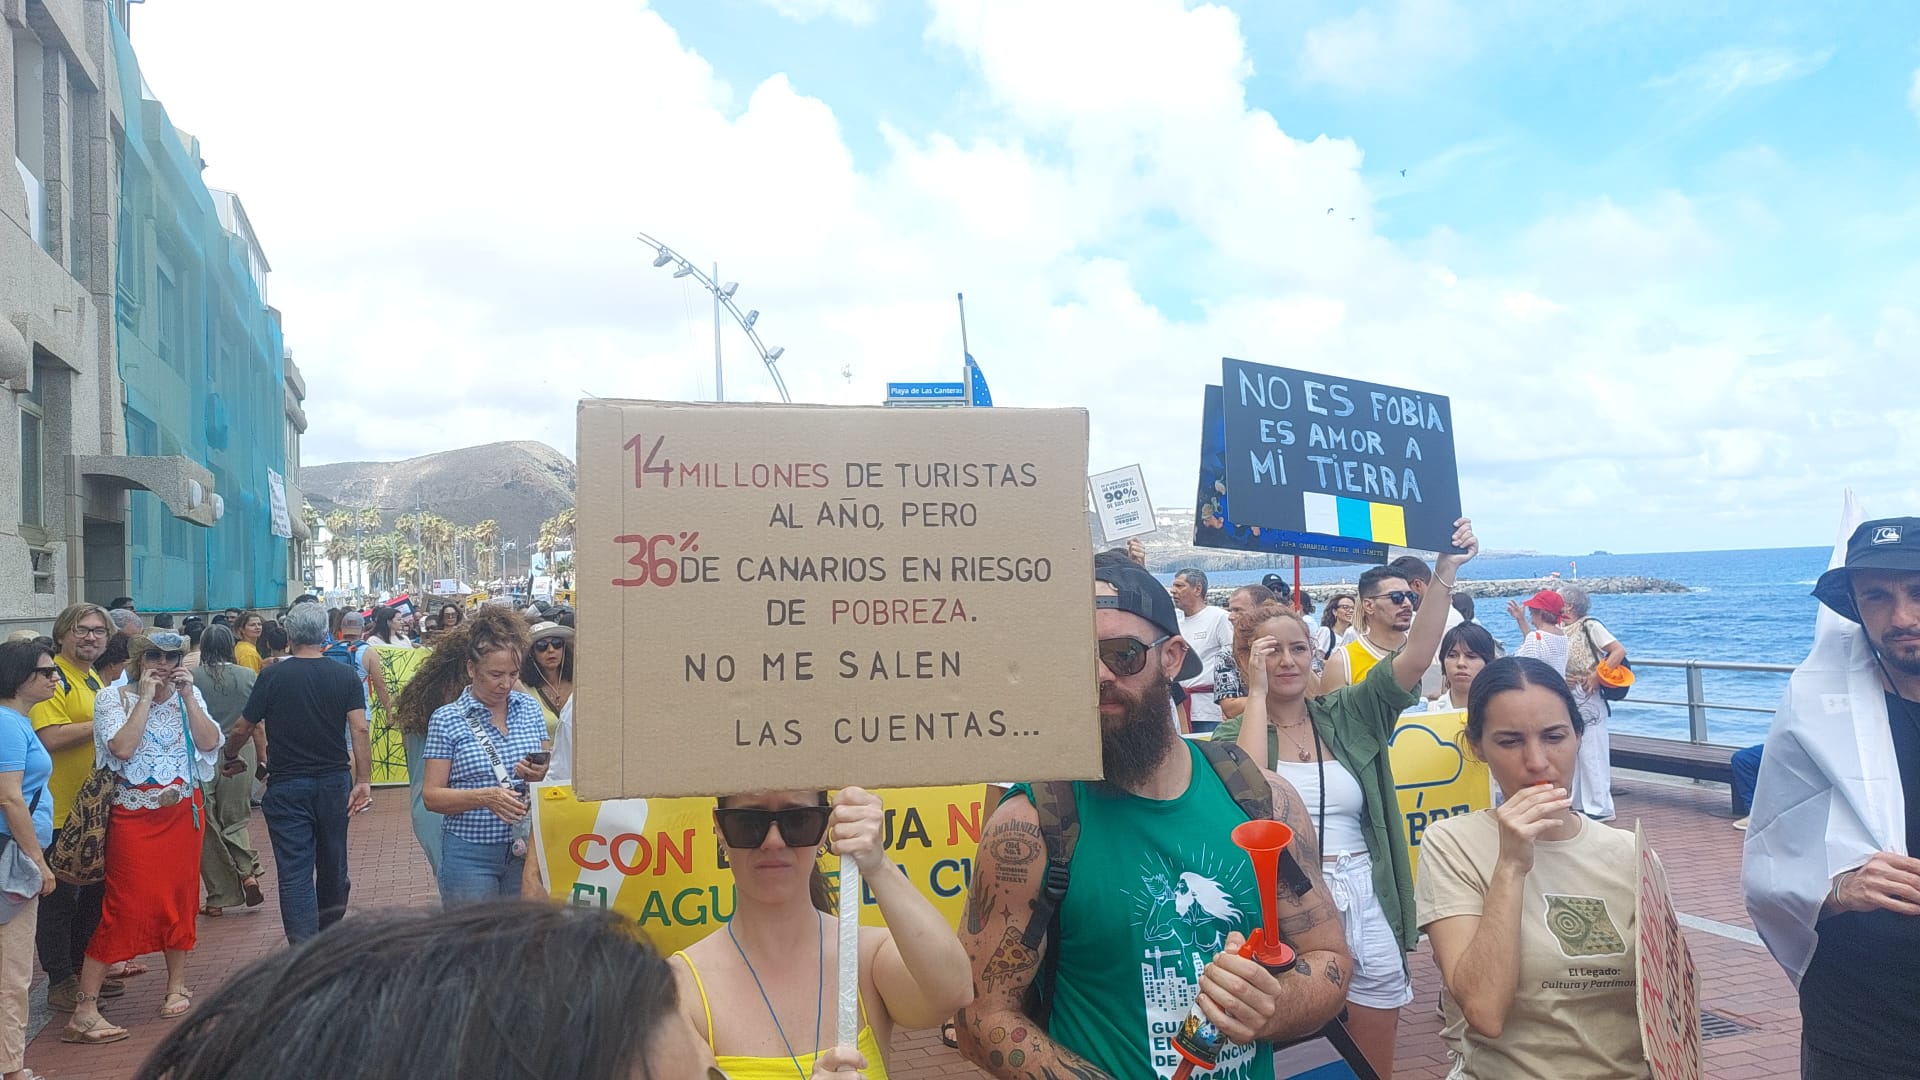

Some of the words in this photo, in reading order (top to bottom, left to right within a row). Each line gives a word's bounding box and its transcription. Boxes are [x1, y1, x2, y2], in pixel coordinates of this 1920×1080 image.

[890, 387, 909, 396] Playa
[1239, 368, 1291, 410] NO
[1304, 380, 1355, 417] ES
[1260, 419, 1295, 445] ES
[1309, 422, 1385, 455] AMOR
[1405, 437, 1422, 461] A
[624, 434, 674, 488] 14
[680, 462, 829, 488] MILLONES
[846, 462, 884, 488] DE
[895, 462, 1037, 488] TURISTAS
[1104, 487, 1138, 502] 90%
[769, 502, 803, 528] AL
[817, 497, 884, 531] AÑO,
[902, 502, 977, 528] PERO
[612, 531, 699, 587] 36%
[680, 556, 720, 583] DE
[737, 556, 886, 582] CANARIOS
[902, 556, 941, 582] EN
[951, 556, 1051, 582] RIESGO
[767, 599, 806, 626] DE
[832, 598, 977, 625] POBREZA.
[685, 653, 736, 682] NO
[763, 652, 813, 681] ME
[839, 650, 960, 680] SALEN
[736, 719, 803, 746] LAS
[834, 710, 1040, 744] CUENTAS...
[569, 828, 696, 876] CON
[1541, 981, 1581, 989] Cultura
[1582, 982, 1588, 991] y
[1590, 979, 1636, 989] Patrimon
[1568, 968, 1579, 977] El
[1580, 967, 1622, 978] Legado:
[1155, 1055, 1177, 1066] DE
